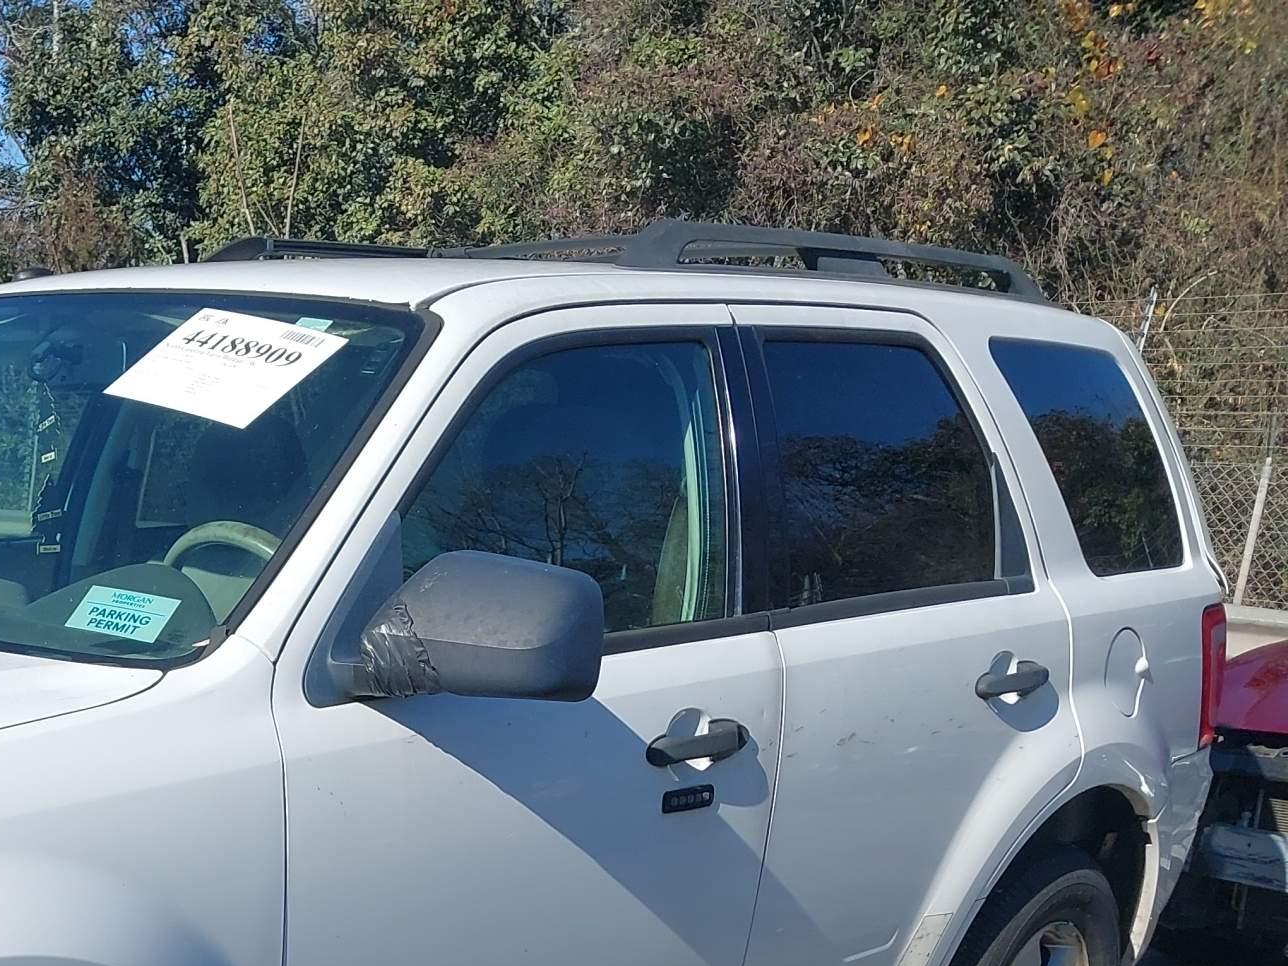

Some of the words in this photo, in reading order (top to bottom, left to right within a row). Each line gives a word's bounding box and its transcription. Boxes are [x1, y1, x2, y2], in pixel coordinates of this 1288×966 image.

[182, 329, 303, 367] 44188909
[112, 592, 153, 605] MORGAN
[88, 606, 152, 626] PARKING
[87, 617, 141, 636] PERMIT
